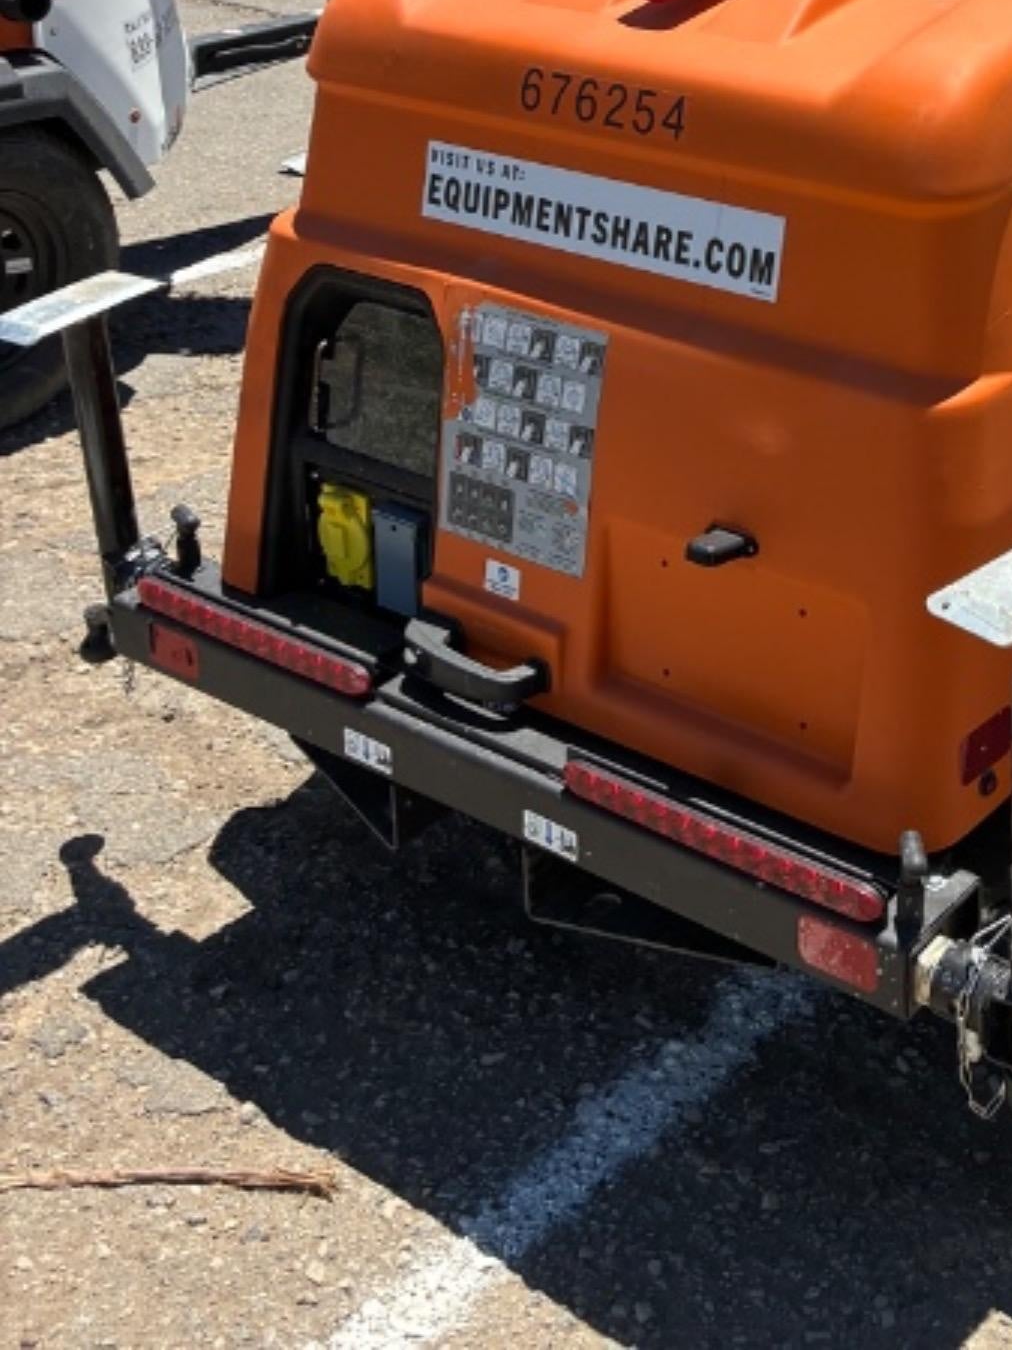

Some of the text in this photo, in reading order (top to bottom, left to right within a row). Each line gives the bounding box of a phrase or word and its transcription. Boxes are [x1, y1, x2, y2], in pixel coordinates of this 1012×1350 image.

[520, 67, 686, 141] 676254
[430, 147, 526, 182] VISIT US AT:
[428, 173, 775, 286] EQUIPMENTSHARE.COM
